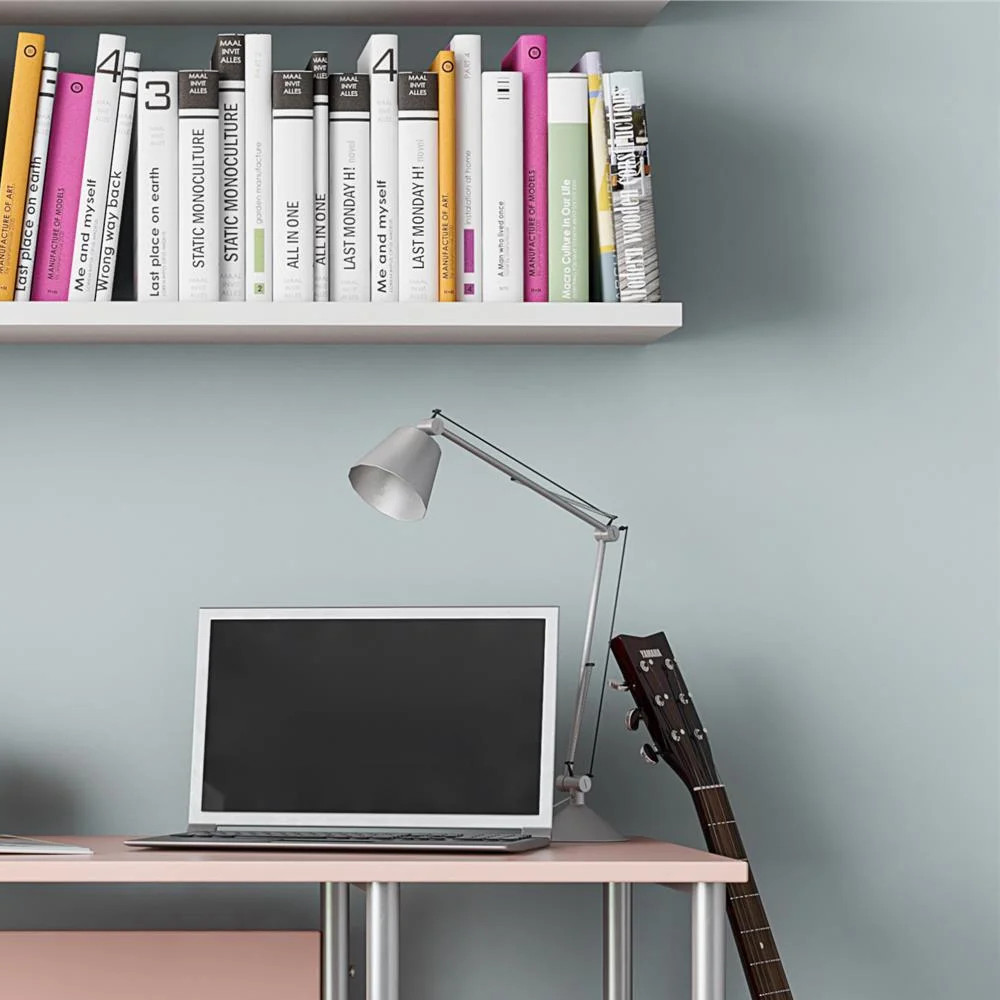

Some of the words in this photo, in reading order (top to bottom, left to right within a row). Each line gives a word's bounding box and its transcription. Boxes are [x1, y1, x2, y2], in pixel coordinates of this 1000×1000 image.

[97, 49, 121, 83] 4
[372, 48, 398, 82] 4
[145, 81, 171, 110] 3
[223, 103, 239, 212] MONOCULTURE
[412, 166, 424, 179] H!
[30, 156, 42, 192] earth
[149, 167, 160, 202] earth
[192, 129, 205, 224] MONOCULTURE
[343, 167, 356, 180] H!
[55, 188, 64, 215] MODELS
[84, 179, 97, 228] myself
[107, 171, 122, 207] back
[5, 201, 11, 213] OF
[26, 197, 36, 215] on
[151, 206, 160, 224] on
[287, 201, 299, 228] ONE
[315, 193, 326, 222] ONE
[343, 183, 356, 238] MONDAY
[377, 180, 388, 229] myself
[412, 182, 424, 237] MONDAY
[441, 210, 449, 221] OF
[529, 205, 536, 215] OF
[561, 197, 571, 215] Our
[614, 189, 643, 244] wooden
[53, 217, 61, 228] OF
[106, 212, 119, 241] way
[287, 230, 299, 244] IN
[315, 225, 326, 238] IN
[20, 219, 34, 261] place
[80, 232, 90, 262] and
[149, 227, 161, 267] place
[192, 227, 205, 268] STATIC
[223, 216, 239, 262] STATIC
[315, 242, 326, 266] ALL
[377, 234, 387, 264] and
[412, 239, 424, 269] LAST
[441, 223, 449, 280] MANUFACTURE
[561, 230, 571, 265] Culture
[48, 229, 60, 280] MANUFACTURE
[97, 248, 115, 291] Wrong
[287, 246, 299, 269] ALL
[343, 240, 356, 270] LAST
[17, 265, 29, 291] Last
[74, 268, 86, 292] Me
[149, 271, 160, 297] Last
[377, 269, 387, 293] Me
[562, 267, 571, 299] Macro
[619, 247, 647, 302] Modern
[640, 648, 663, 658] YAMAHA
